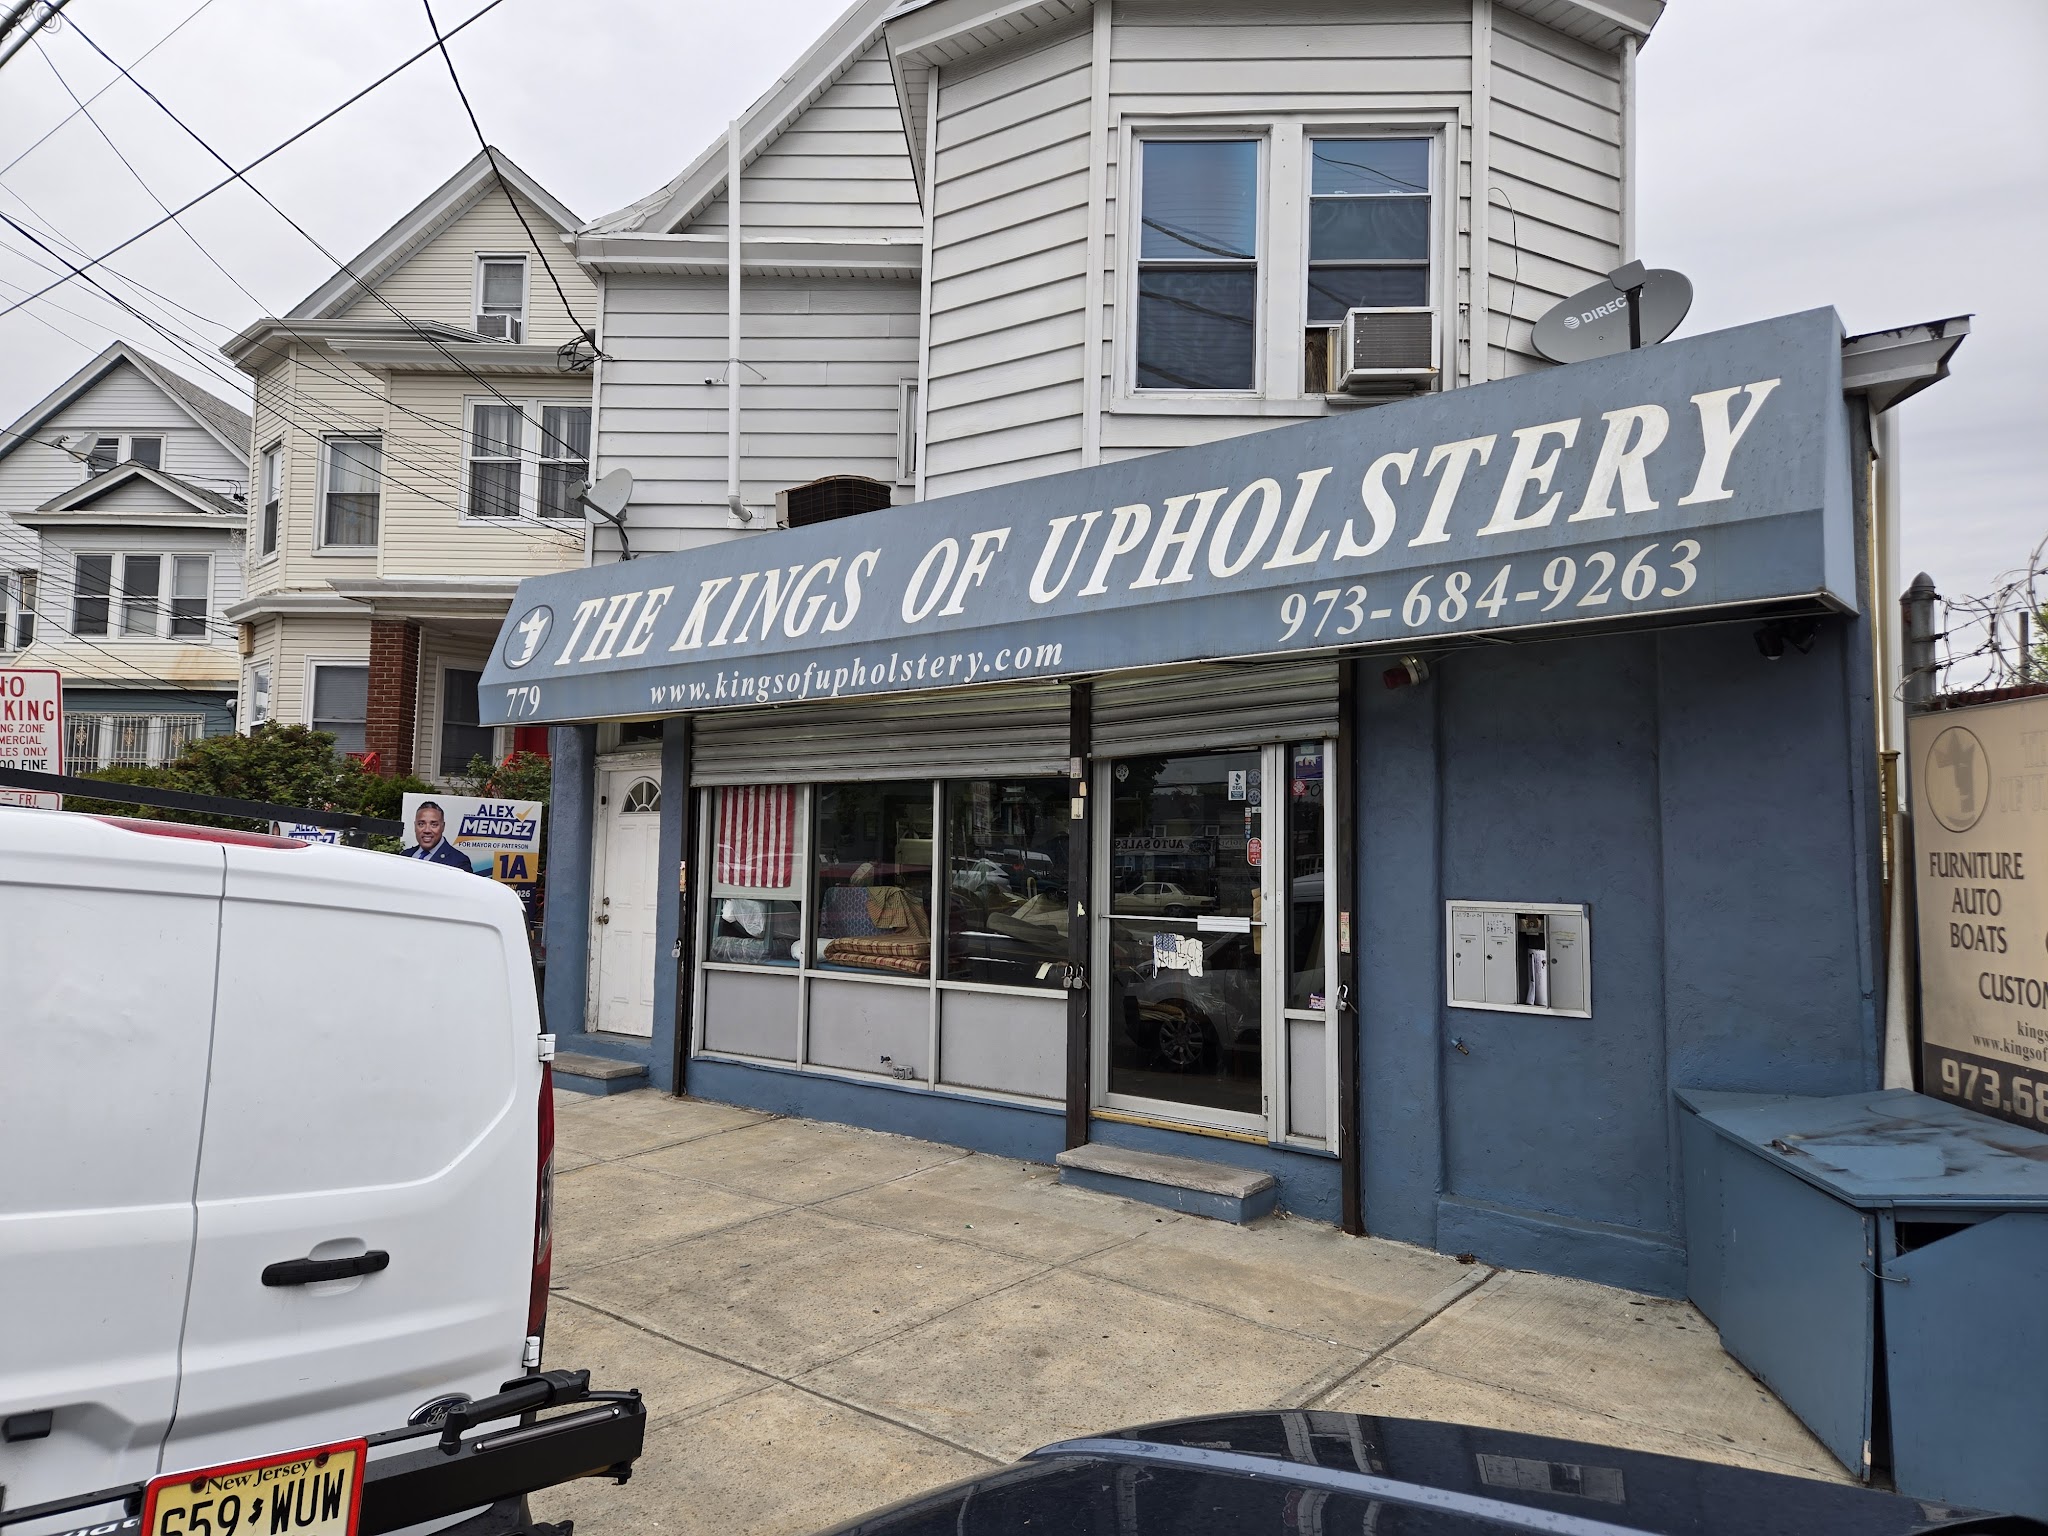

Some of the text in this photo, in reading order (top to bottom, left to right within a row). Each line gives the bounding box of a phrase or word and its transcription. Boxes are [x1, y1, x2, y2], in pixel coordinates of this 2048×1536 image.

[1580, 288, 1643, 323] DIREC
[553, 377, 1782, 666] THE KINGS OF UPHOLSTERY
[1278, 539, 1701, 643] 973-684-9263
[649, 642, 1063, 704] www.kingsofupholstery.com
[505, 685, 541, 718] 779
[18, 723, 46, 733] ZONE
[21, 759, 48, 770] FINE
[23, 746, 48, 757] ONLY
[19, 793, 37, 805] FRI
[476, 803, 516, 819] ALEX
[461, 819, 533, 837] MENDEZ
[471, 841, 492, 849] MAYOR
[501, 842, 529, 850] PATERSON
[499, 854, 529, 880] 1A
[1928, 851, 2025, 880] FURNITURE
[516, 889, 531, 898] 026
[1951, 887, 2002, 917] AUTO
[1949, 922, 2008, 954] BOATS
[1978, 971, 2048, 1010] CUSTO
[204, 1459, 313, 1496] New Jersey
[270, 1468, 346, 1536] WUW
